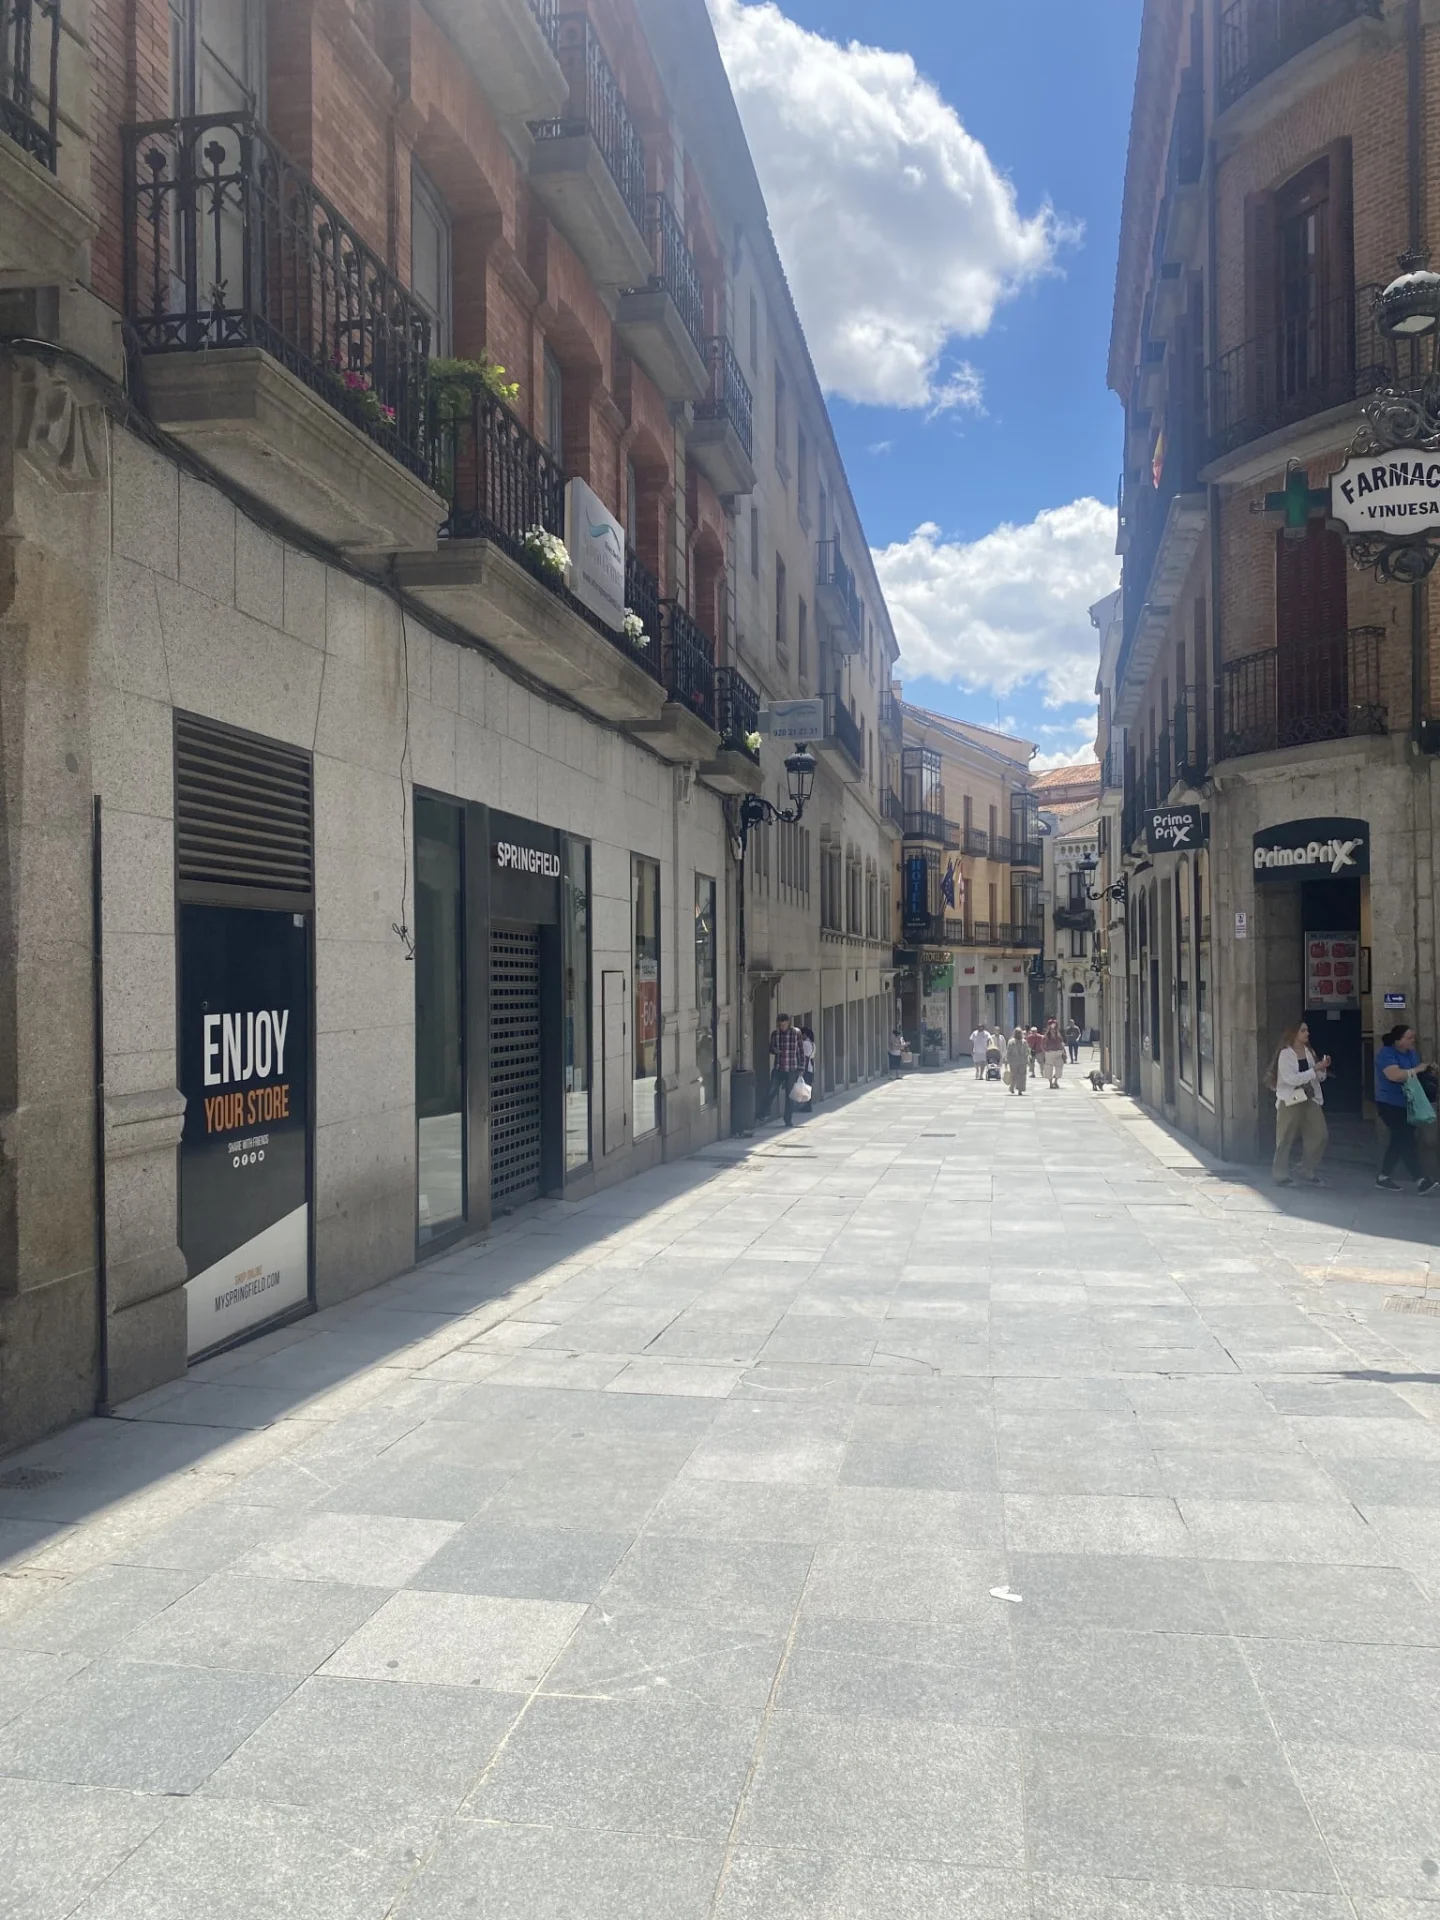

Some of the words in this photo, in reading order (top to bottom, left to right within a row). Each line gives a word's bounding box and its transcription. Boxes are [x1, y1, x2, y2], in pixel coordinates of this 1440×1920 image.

[1368, 501, 1440, 518] VINUESA
[1153, 814, 1193, 828] Prima
[497, 841, 560, 878] SPRINGFIELD
[911, 860, 921, 913] HOTEL
[204, 1010, 290, 1086] ENJOY
[204, 1092, 244, 1133] YOUR
[247, 1084, 290, 1124] STORE
[227, 1140, 242, 1153] SHARE
[253, 1134, 270, 1148] FRIENDS
[214, 1270, 280, 1313] MYSPRINGFIELD.COM
